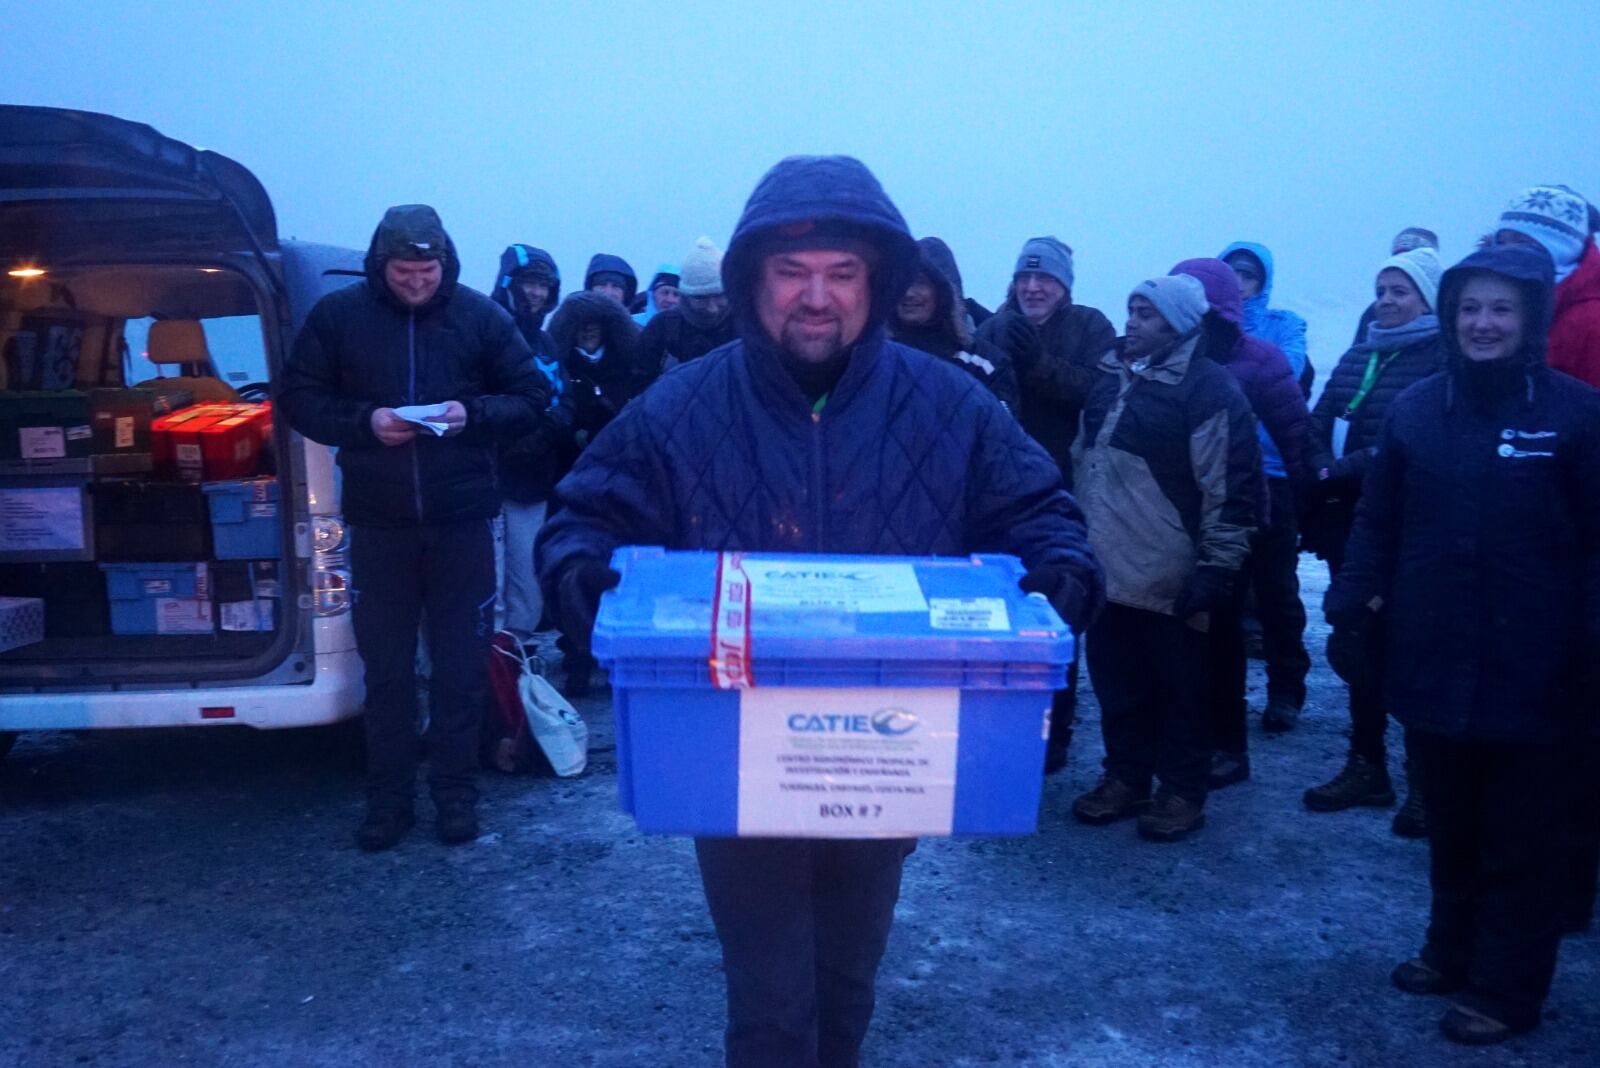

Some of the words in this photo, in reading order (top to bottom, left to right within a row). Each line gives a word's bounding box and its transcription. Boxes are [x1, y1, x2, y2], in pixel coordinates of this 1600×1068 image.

[787, 714, 871, 733] CATIE
[820, 804, 854, 818] BOX
[859, 804, 869, 817] #
[873, 804, 883, 818] 7
